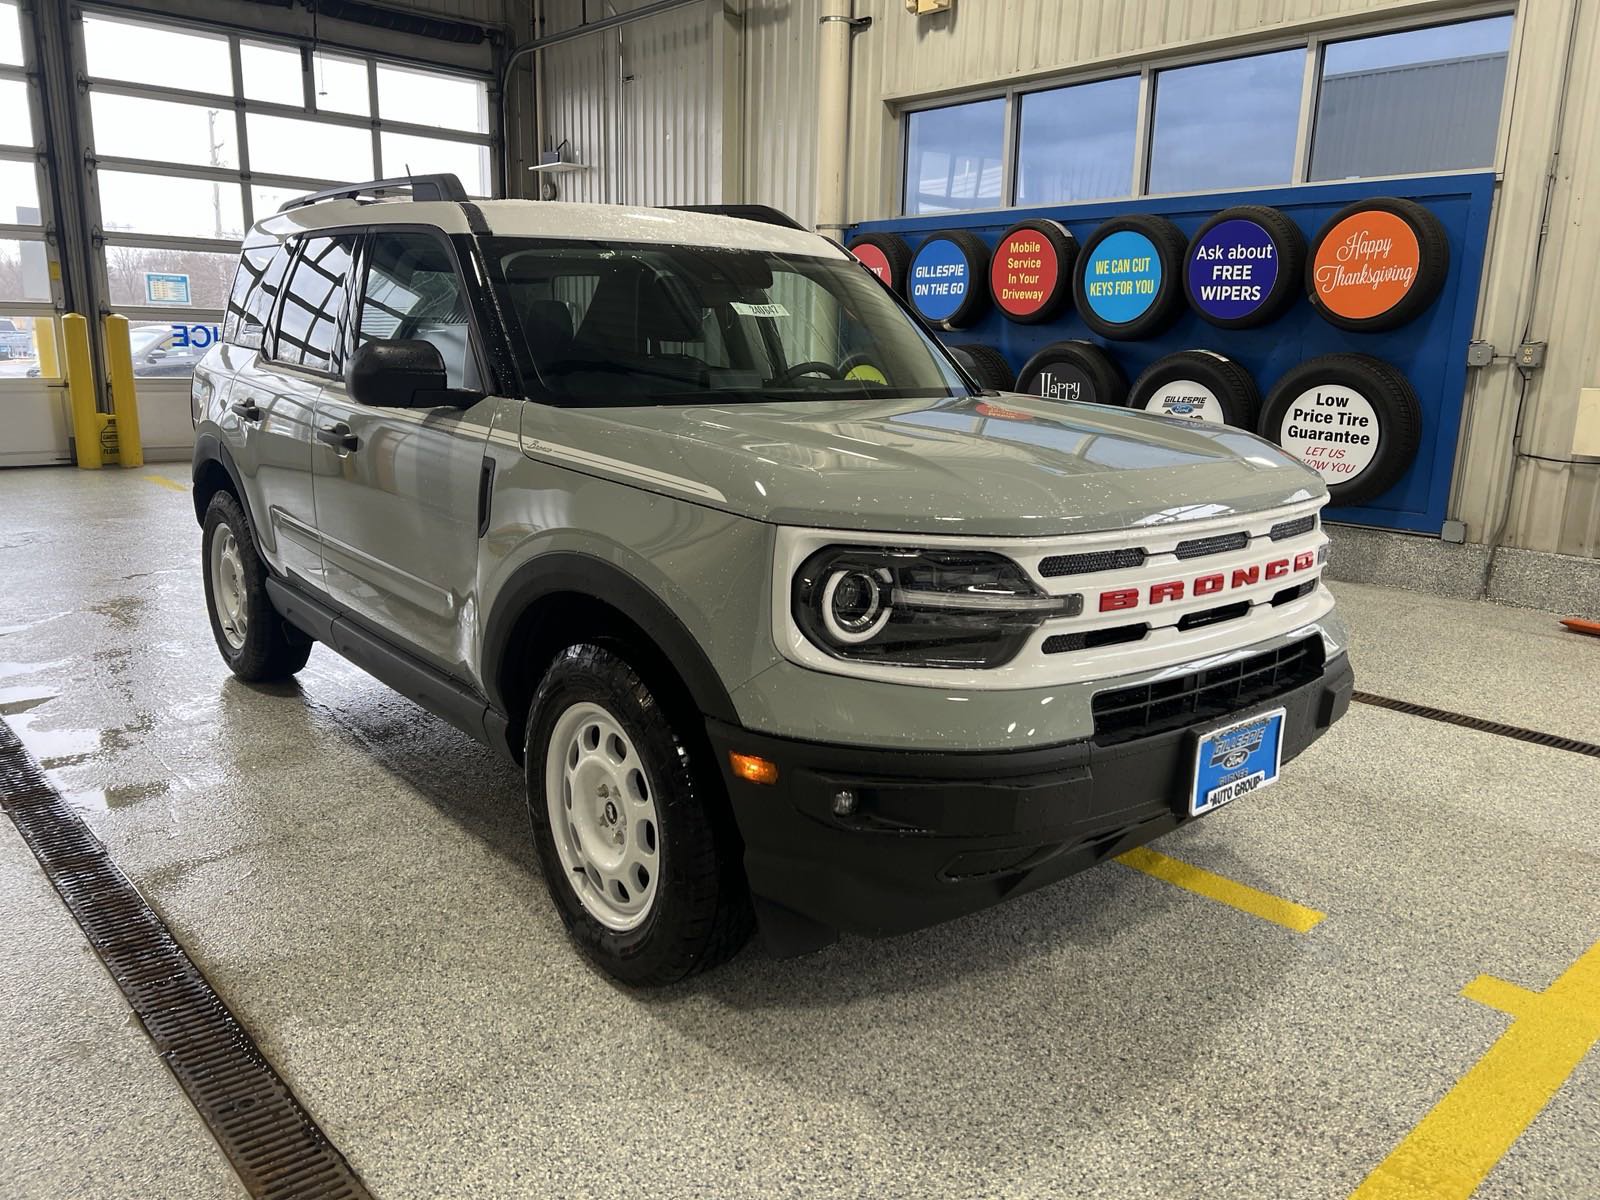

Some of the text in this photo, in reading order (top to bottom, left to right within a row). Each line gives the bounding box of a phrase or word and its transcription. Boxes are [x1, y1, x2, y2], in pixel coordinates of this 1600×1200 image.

[1010, 242, 1041, 253] Mobile
[1196, 244, 1273, 260] Ask about
[1337, 230, 1392, 261] Happy
[916, 264, 964, 278] GILLESPIE
[1008, 258, 1041, 269] Service
[1095, 257, 1151, 275] WE CAN CUT
[1008, 272, 1039, 284] In Your
[1212, 265, 1252, 280] FREE
[1316, 264, 1414, 293] Thanksgiving
[915, 282, 964, 295] ON THE GO
[1002, 288, 1044, 302] Driveway
[1090, 279, 1154, 296] KEYS FOR YOU
[1200, 285, 1261, 301] WIPERS
[1040, 372, 1080, 400] Happy
[1164, 395, 1207, 404] GILLESPIE
[1316, 393, 1349, 407] Low
[1293, 408, 1369, 427] Price Tire
[1288, 425, 1370, 445] Guarantee
[1305, 446, 1346, 459] LET US
[1331, 462, 1356, 474] YOU
[1099, 551, 1314, 612] BRONCO
[1214, 726, 1266, 756] GILLESPIE
[1211, 775, 1261, 806] AUTO GROUP
